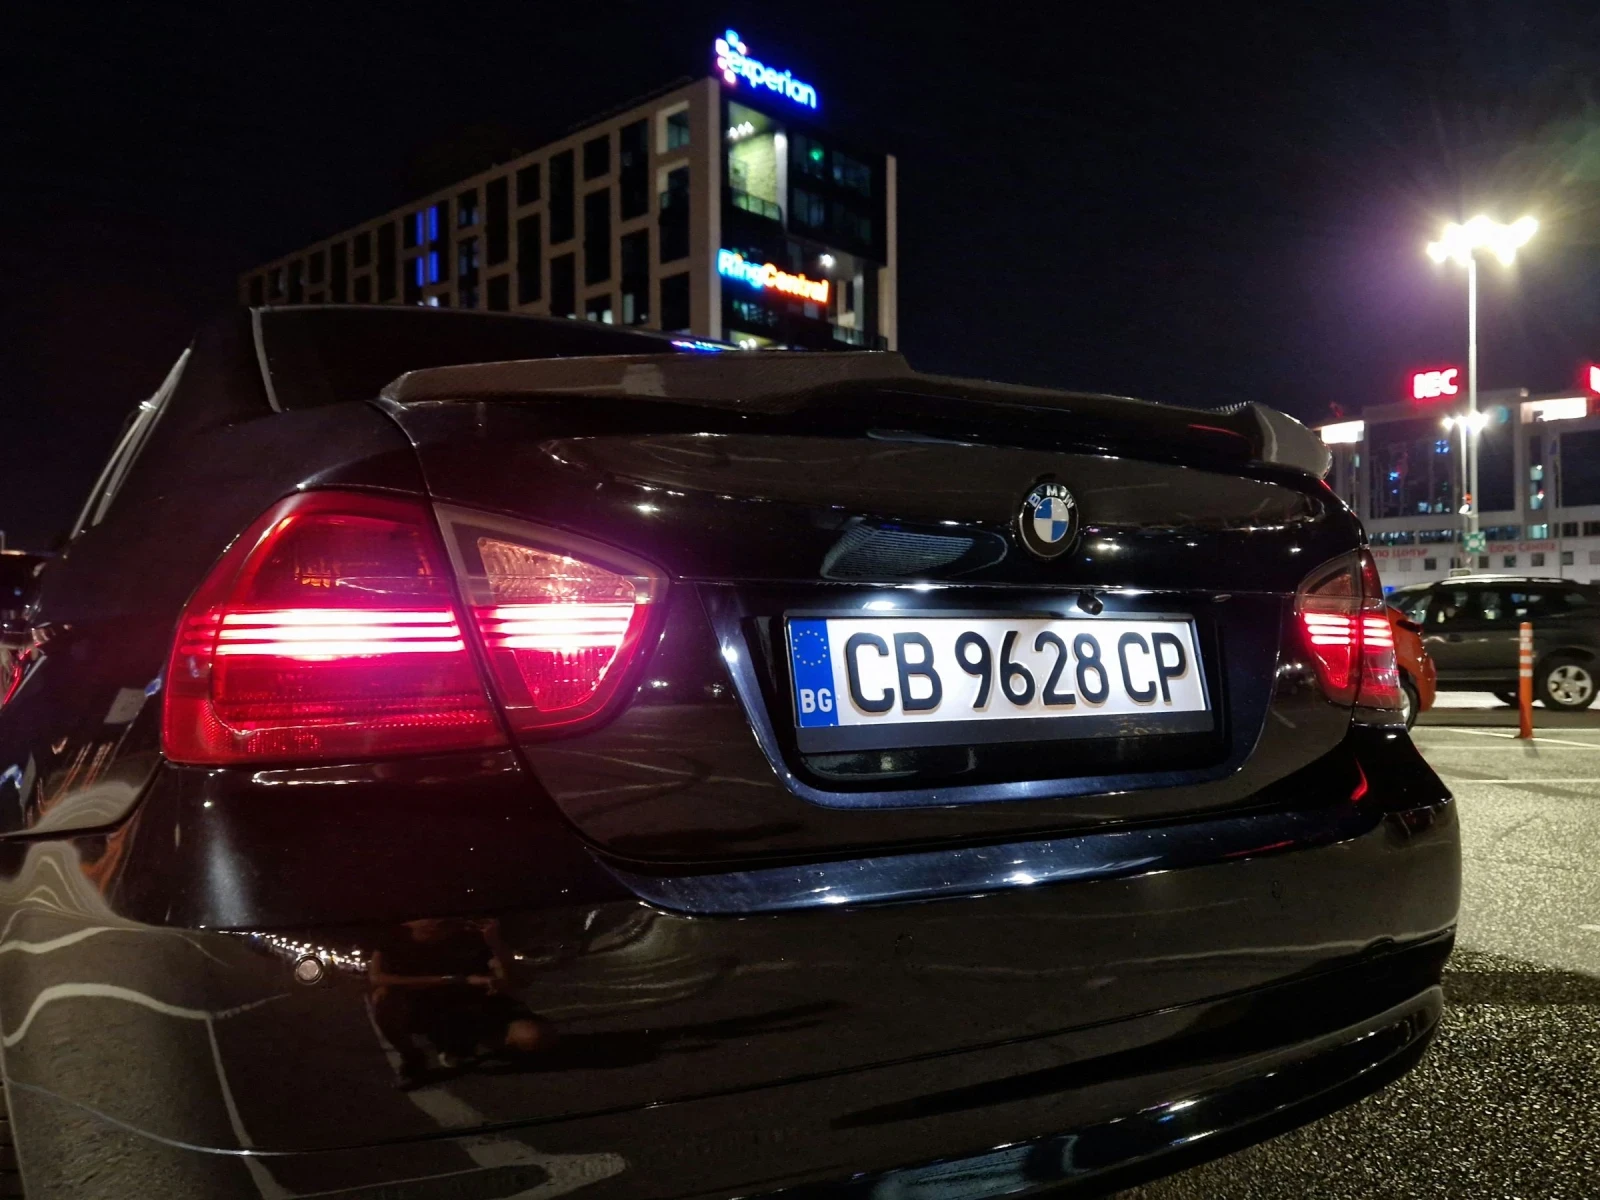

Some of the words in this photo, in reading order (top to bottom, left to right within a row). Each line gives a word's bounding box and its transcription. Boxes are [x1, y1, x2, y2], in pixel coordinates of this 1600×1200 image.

[727, 50, 817, 109] experian
[718, 248, 829, 303] RingCentral
[1028, 485, 1075, 509] BMW
[845, 632, 943, 713] CB
[954, 630, 1110, 709] 9628
[1117, 631, 1188, 703] CP
[800, 688, 833, 714] BG
